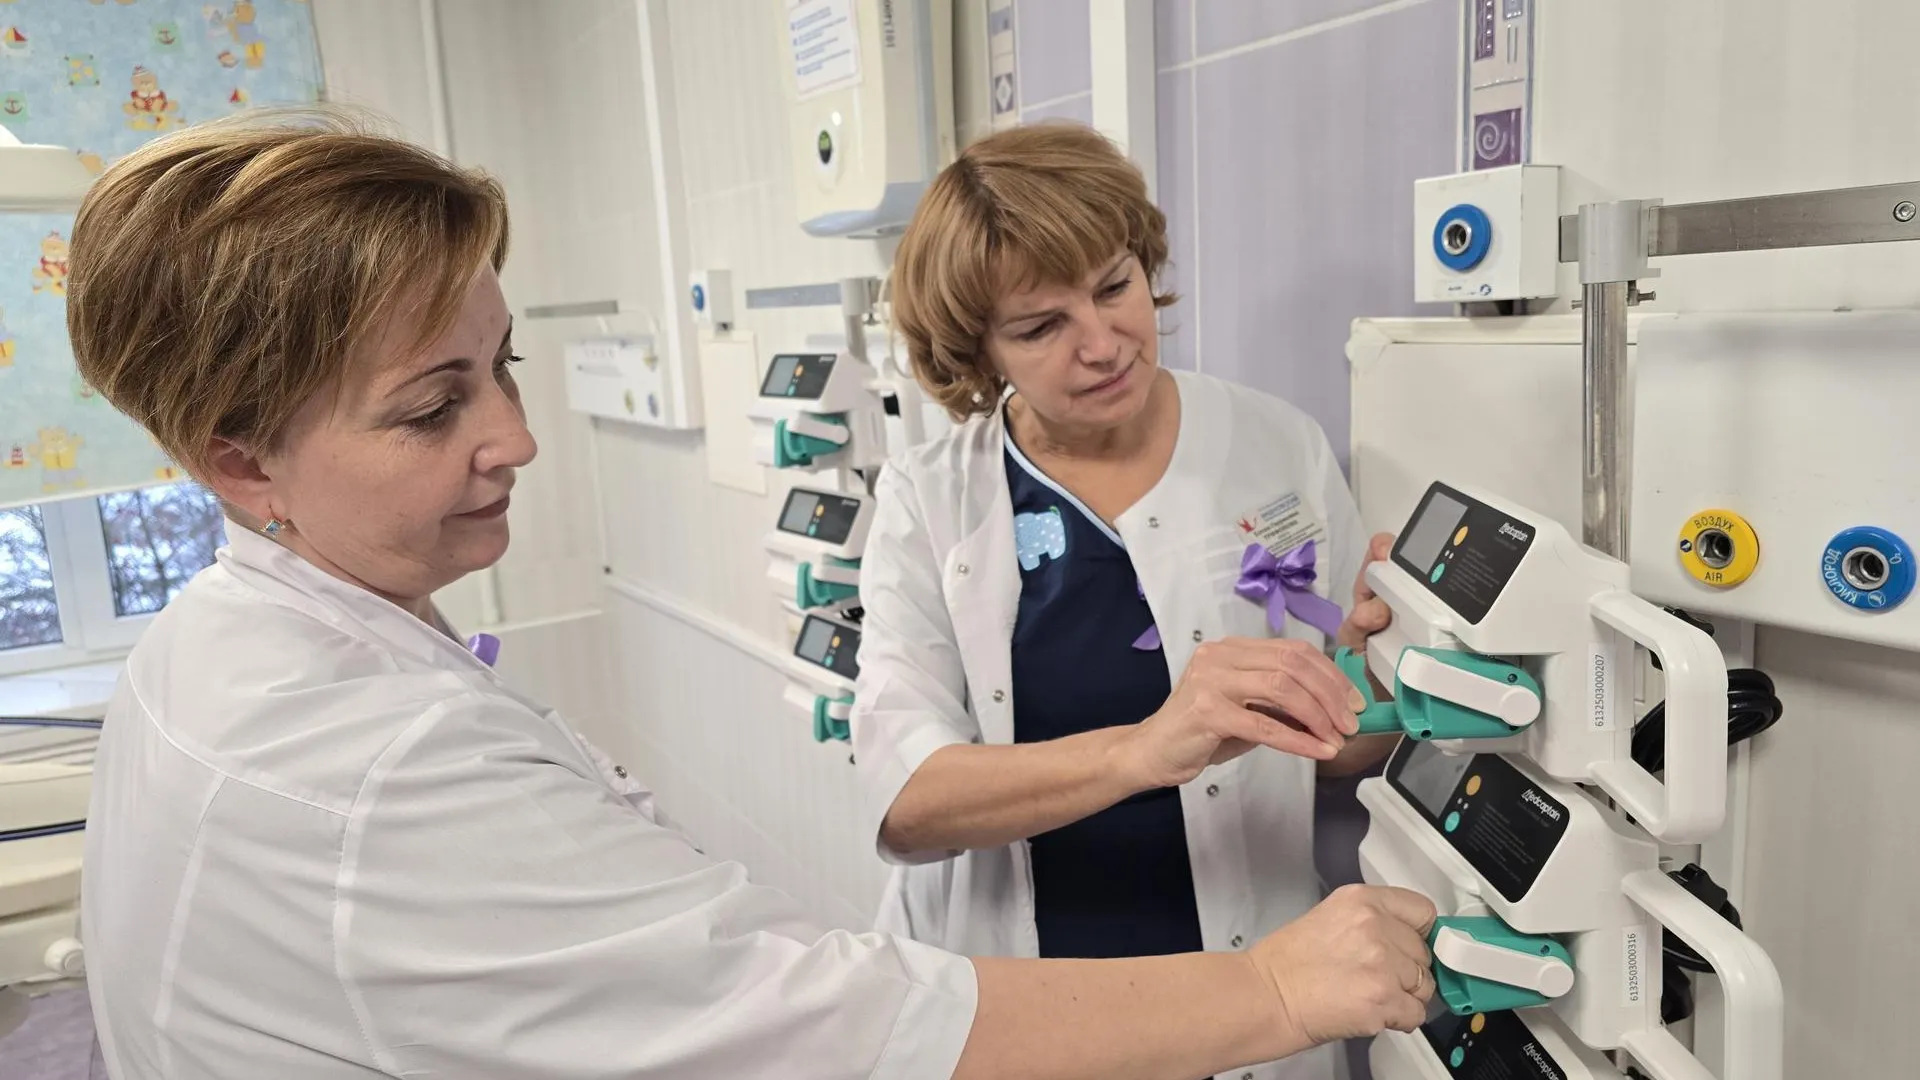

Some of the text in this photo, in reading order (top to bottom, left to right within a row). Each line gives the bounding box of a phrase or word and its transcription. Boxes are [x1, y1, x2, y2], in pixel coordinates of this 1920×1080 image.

[1694, 515, 1734, 532] ВОЗДУХ
[1704, 571, 1723, 582] AIR
[1824, 547, 1858, 604] КИСЛОРОД
[1594, 654, 1605, 727] 6132503000207
[1521, 788, 1561, 822] Medcaptain
[1627, 933, 1639, 1002] 6132503000316
